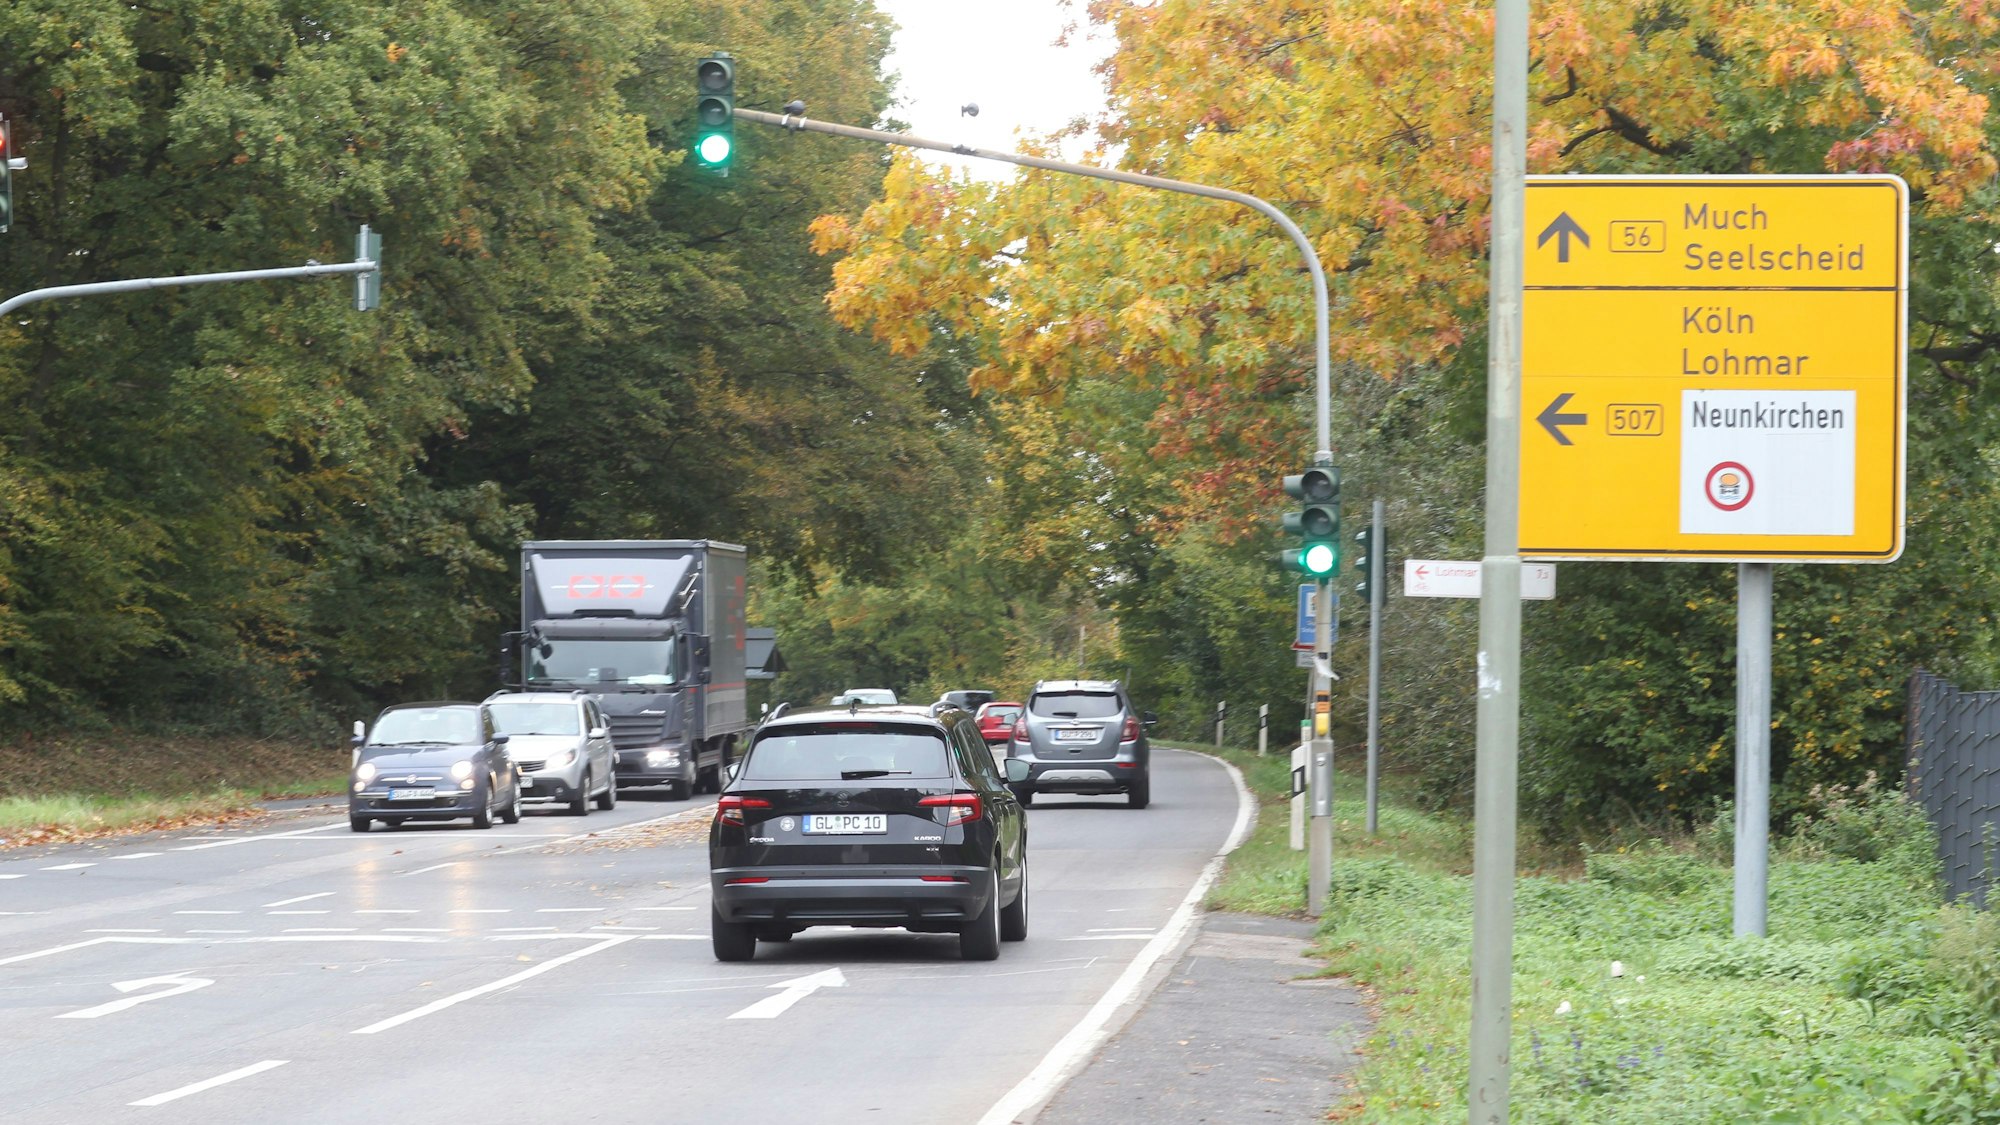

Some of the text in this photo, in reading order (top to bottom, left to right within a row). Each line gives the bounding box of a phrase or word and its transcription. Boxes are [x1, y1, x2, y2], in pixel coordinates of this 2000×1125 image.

[1683, 202, 1768, 230] Much
[1622, 225, 1652, 248] 56
[1684, 243, 1865, 271] Seelscheid
[1682, 306, 1755, 334] Köln
[1682, 347, 1809, 376] Lohmar
[1612, 409, 1657, 431] 507
[1691, 400, 1844, 430] Neunkirchen
[1435, 566, 1478, 578] Lohmar
[815, 816, 881, 830] GL PC 10
